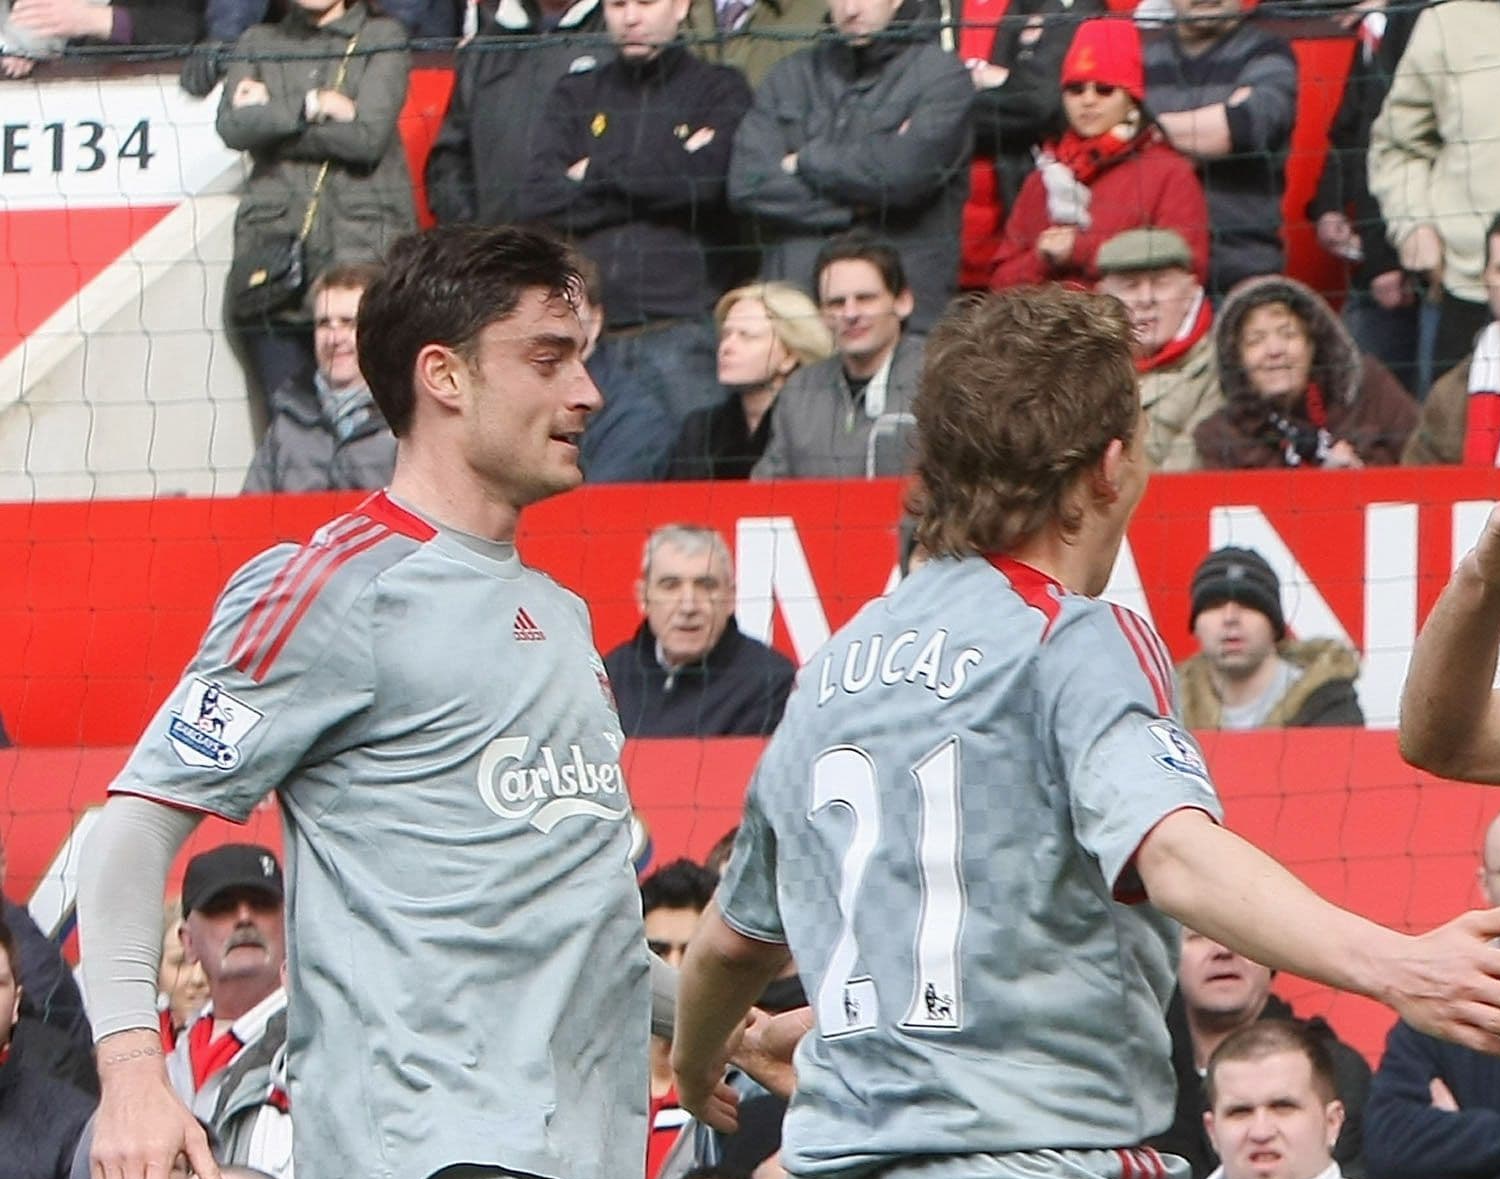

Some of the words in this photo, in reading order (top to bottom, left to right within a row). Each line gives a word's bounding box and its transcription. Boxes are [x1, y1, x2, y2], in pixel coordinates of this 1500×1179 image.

[3, 119, 156, 174] E134
[817, 628, 985, 708] LUCAS
[806, 733, 968, 1041] 21
